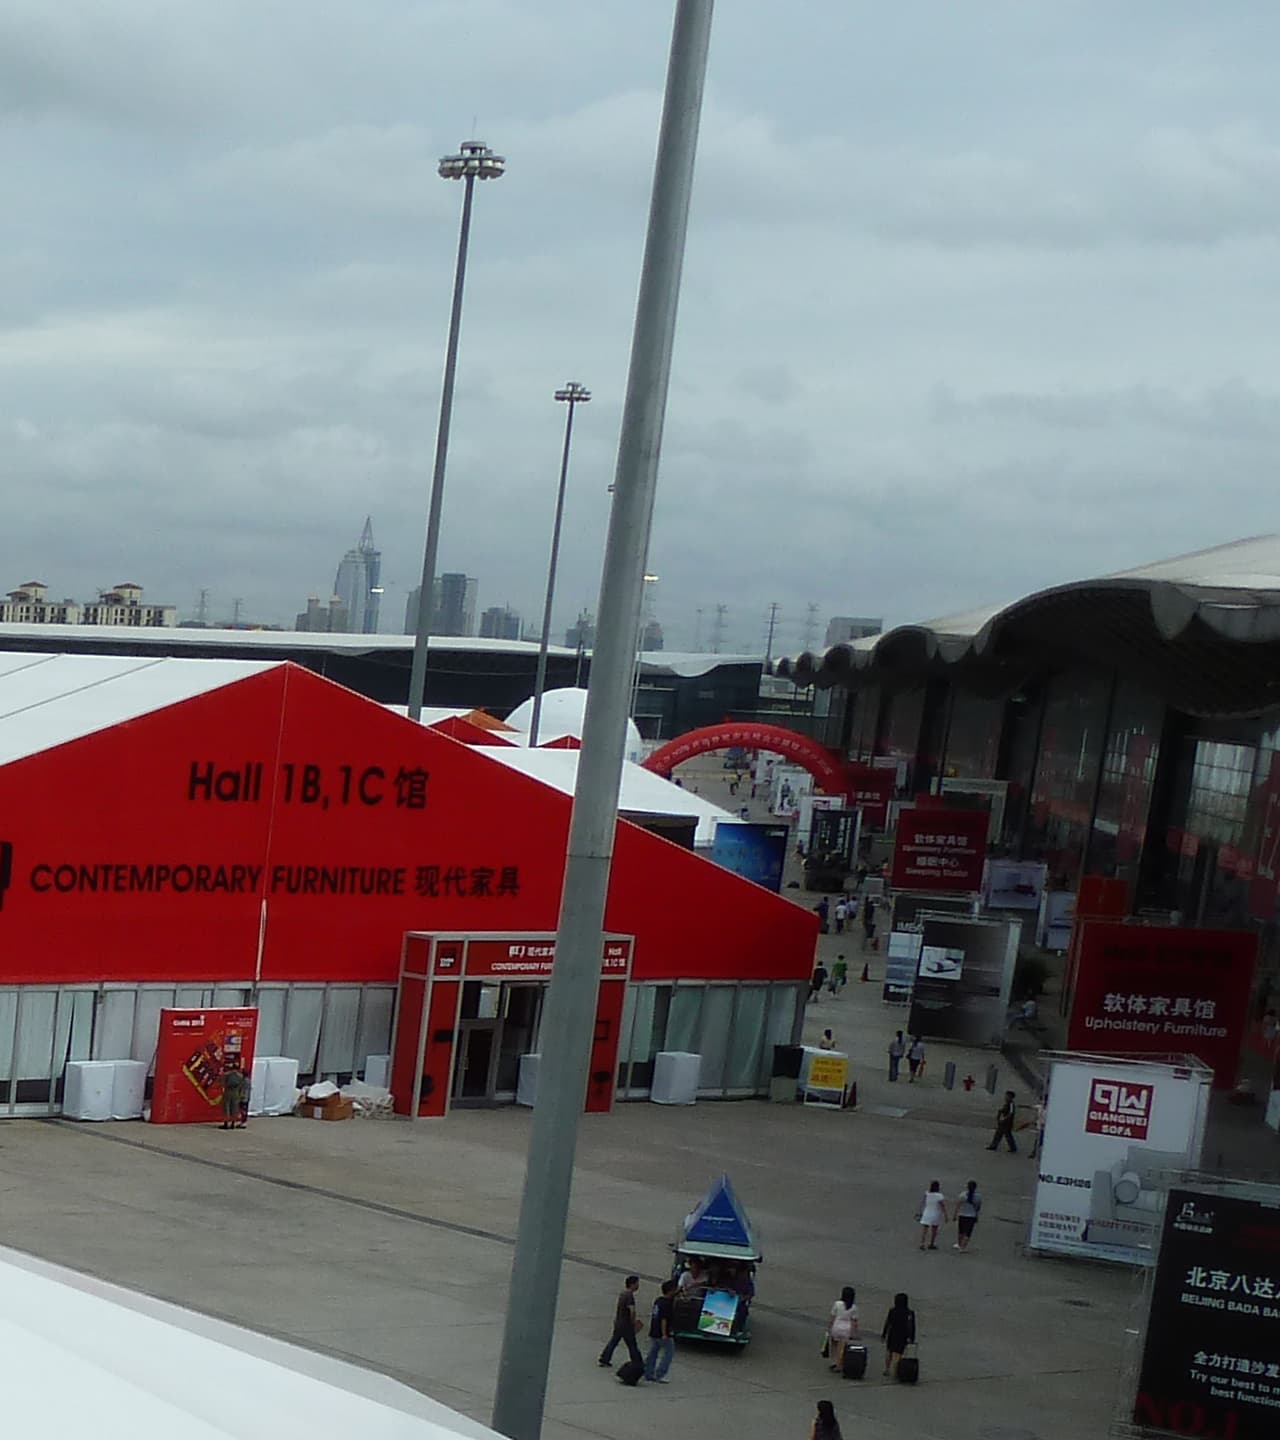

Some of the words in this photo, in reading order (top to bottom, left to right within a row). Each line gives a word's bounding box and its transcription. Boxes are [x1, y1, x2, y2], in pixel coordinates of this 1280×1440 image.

[188, 761, 262, 803] Hall
[29, 863, 262, 894] CONTEMPORARY
[271, 864, 406, 895] FURNITURE
[415, 866, 521, 897] 现代家具
[1103, 991, 1217, 1020] 软体家具馆
[1084, 1015, 1161, 1036] Upholstery
[1164, 1020, 1229, 1038] Furniture
[1089, 1110, 1148, 1127] QIANGWEI
[1101, 1124, 1132, 1137] SOFA
[1184, 1265, 1280, 1299] 北京八达
[1227, 1300, 1260, 1316] BADA
[1189, 1368, 1208, 1383] Try
[1209, 1375, 1230, 1385] our
[1231, 1377, 1256, 1390] best
[1258, 1383, 1270, 1393] to
[1209, 1384, 1235, 1399] best
